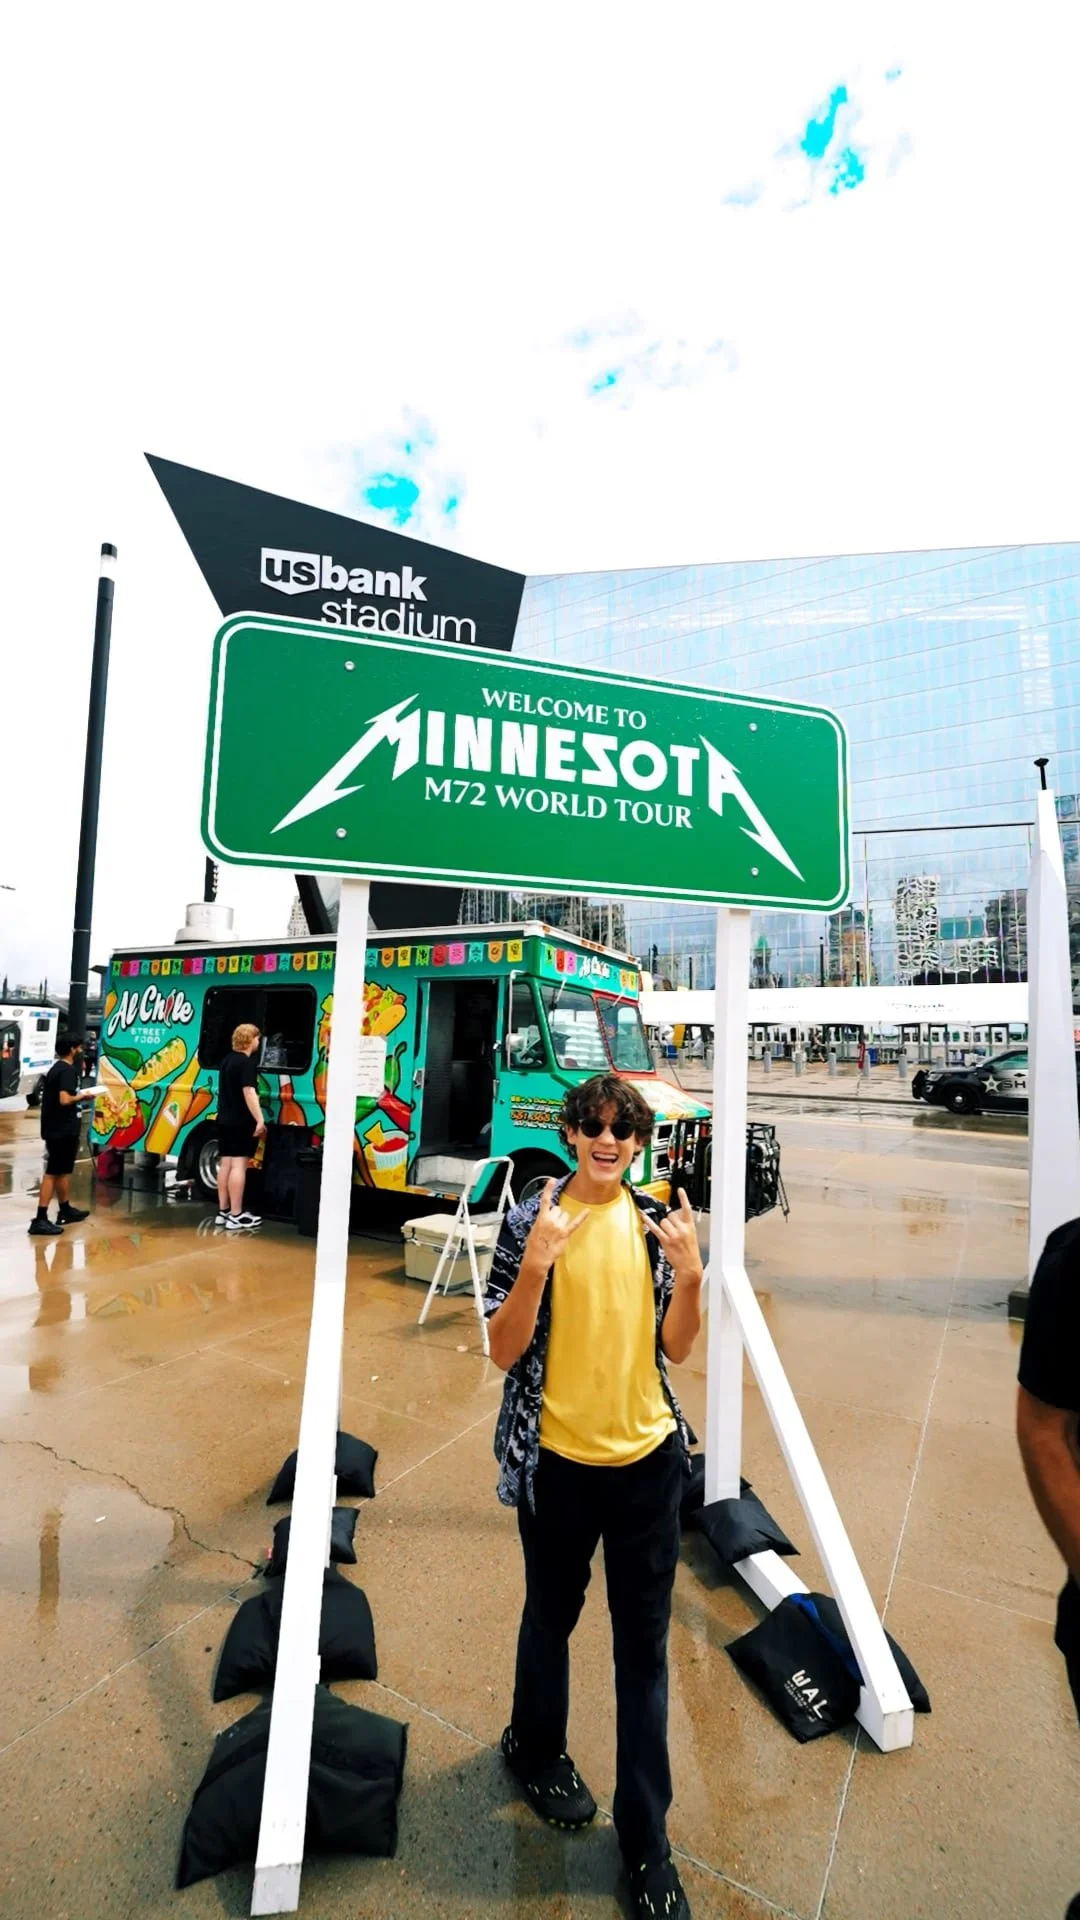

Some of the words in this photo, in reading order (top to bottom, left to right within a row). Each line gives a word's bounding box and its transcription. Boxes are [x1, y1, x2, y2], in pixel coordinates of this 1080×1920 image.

[320, 598, 477, 644] stadium
[481, 687, 609, 726] WELCOME
[614, 708, 647, 730] TO
[270, 693, 806, 882] MINNESOTA
[425, 776, 487, 807] M72
[495, 784, 608, 820] WORLD
[614, 798, 692, 829] TOUR
[107, 990, 139, 1036] Al
[139, 984, 194, 1027] Chile
[130, 1027, 167, 1036] STREET
[134, 1036, 161, 1044] FOOD
[791, 1669, 828, 1719] WAL
